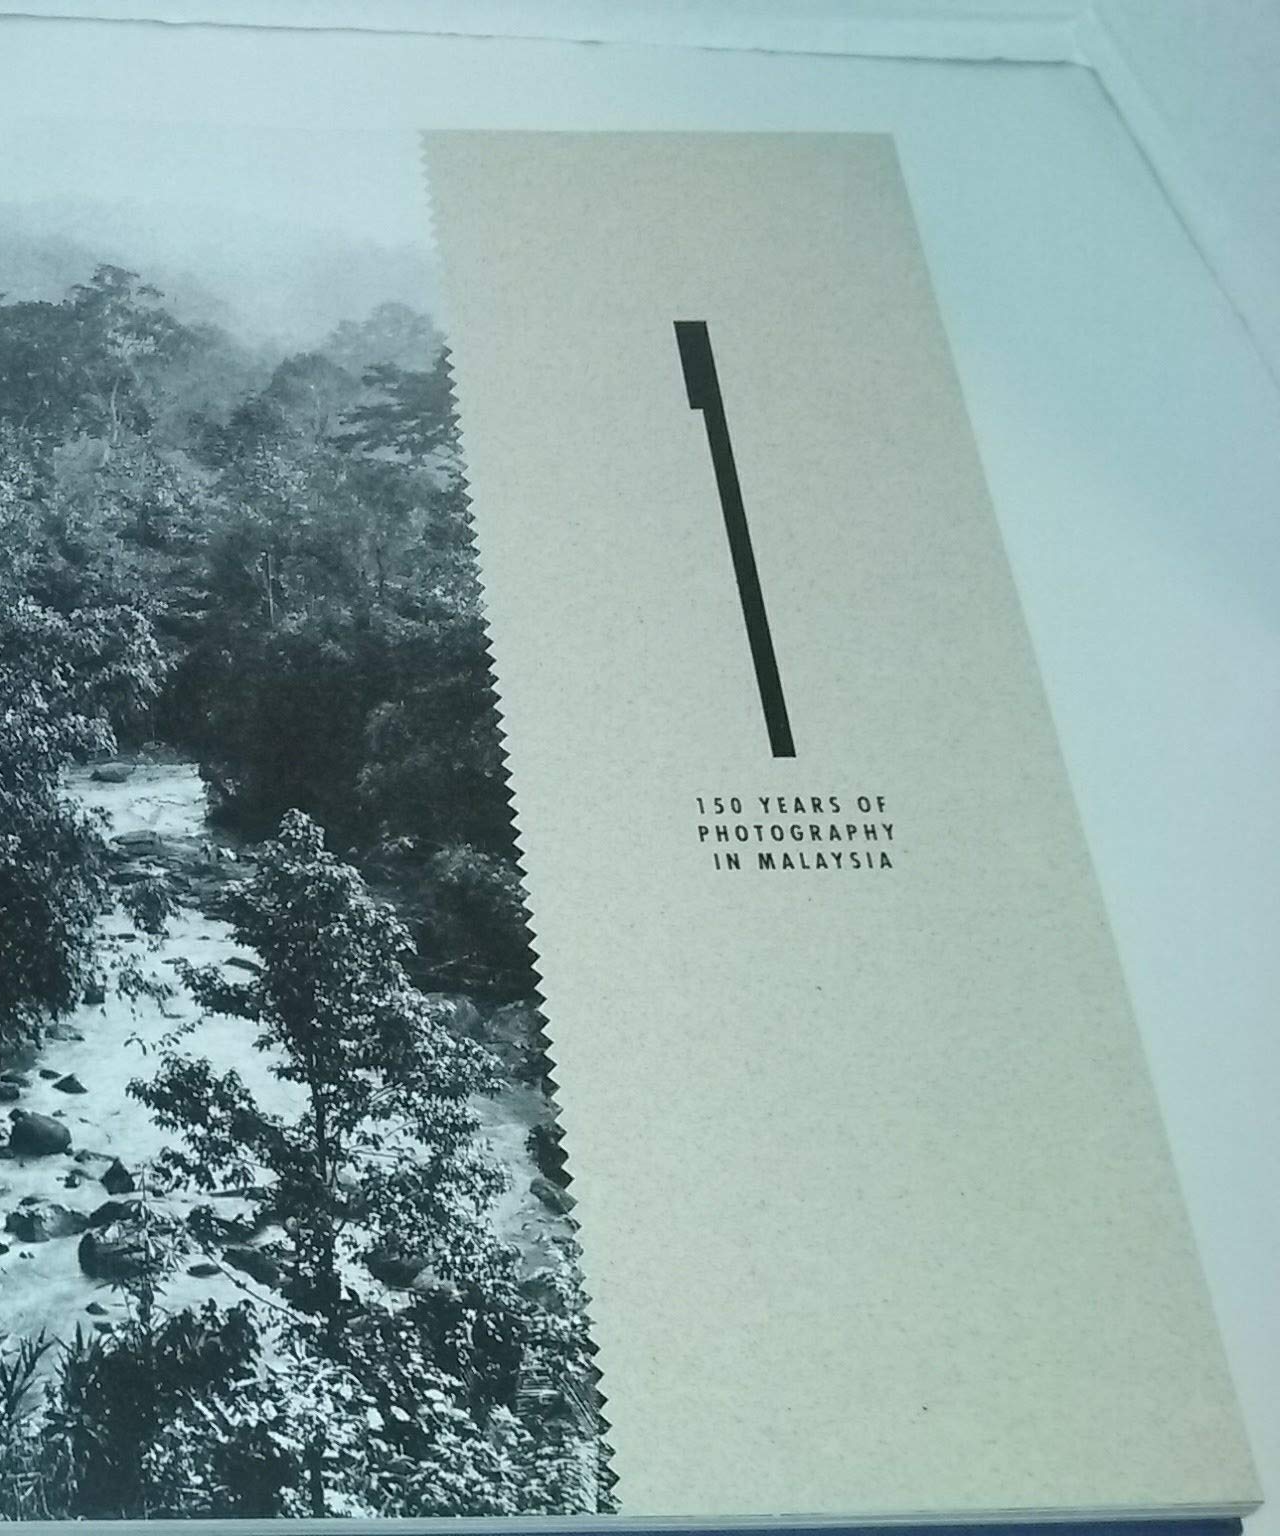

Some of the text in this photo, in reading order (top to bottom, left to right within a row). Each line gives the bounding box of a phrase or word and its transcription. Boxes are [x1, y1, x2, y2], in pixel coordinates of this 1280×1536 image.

[696, 796, 886, 815] 150 YEARS OF
[697, 824, 894, 843] PHOTOGRAPHY
[713, 852, 893, 871] IN MALAYSIA
